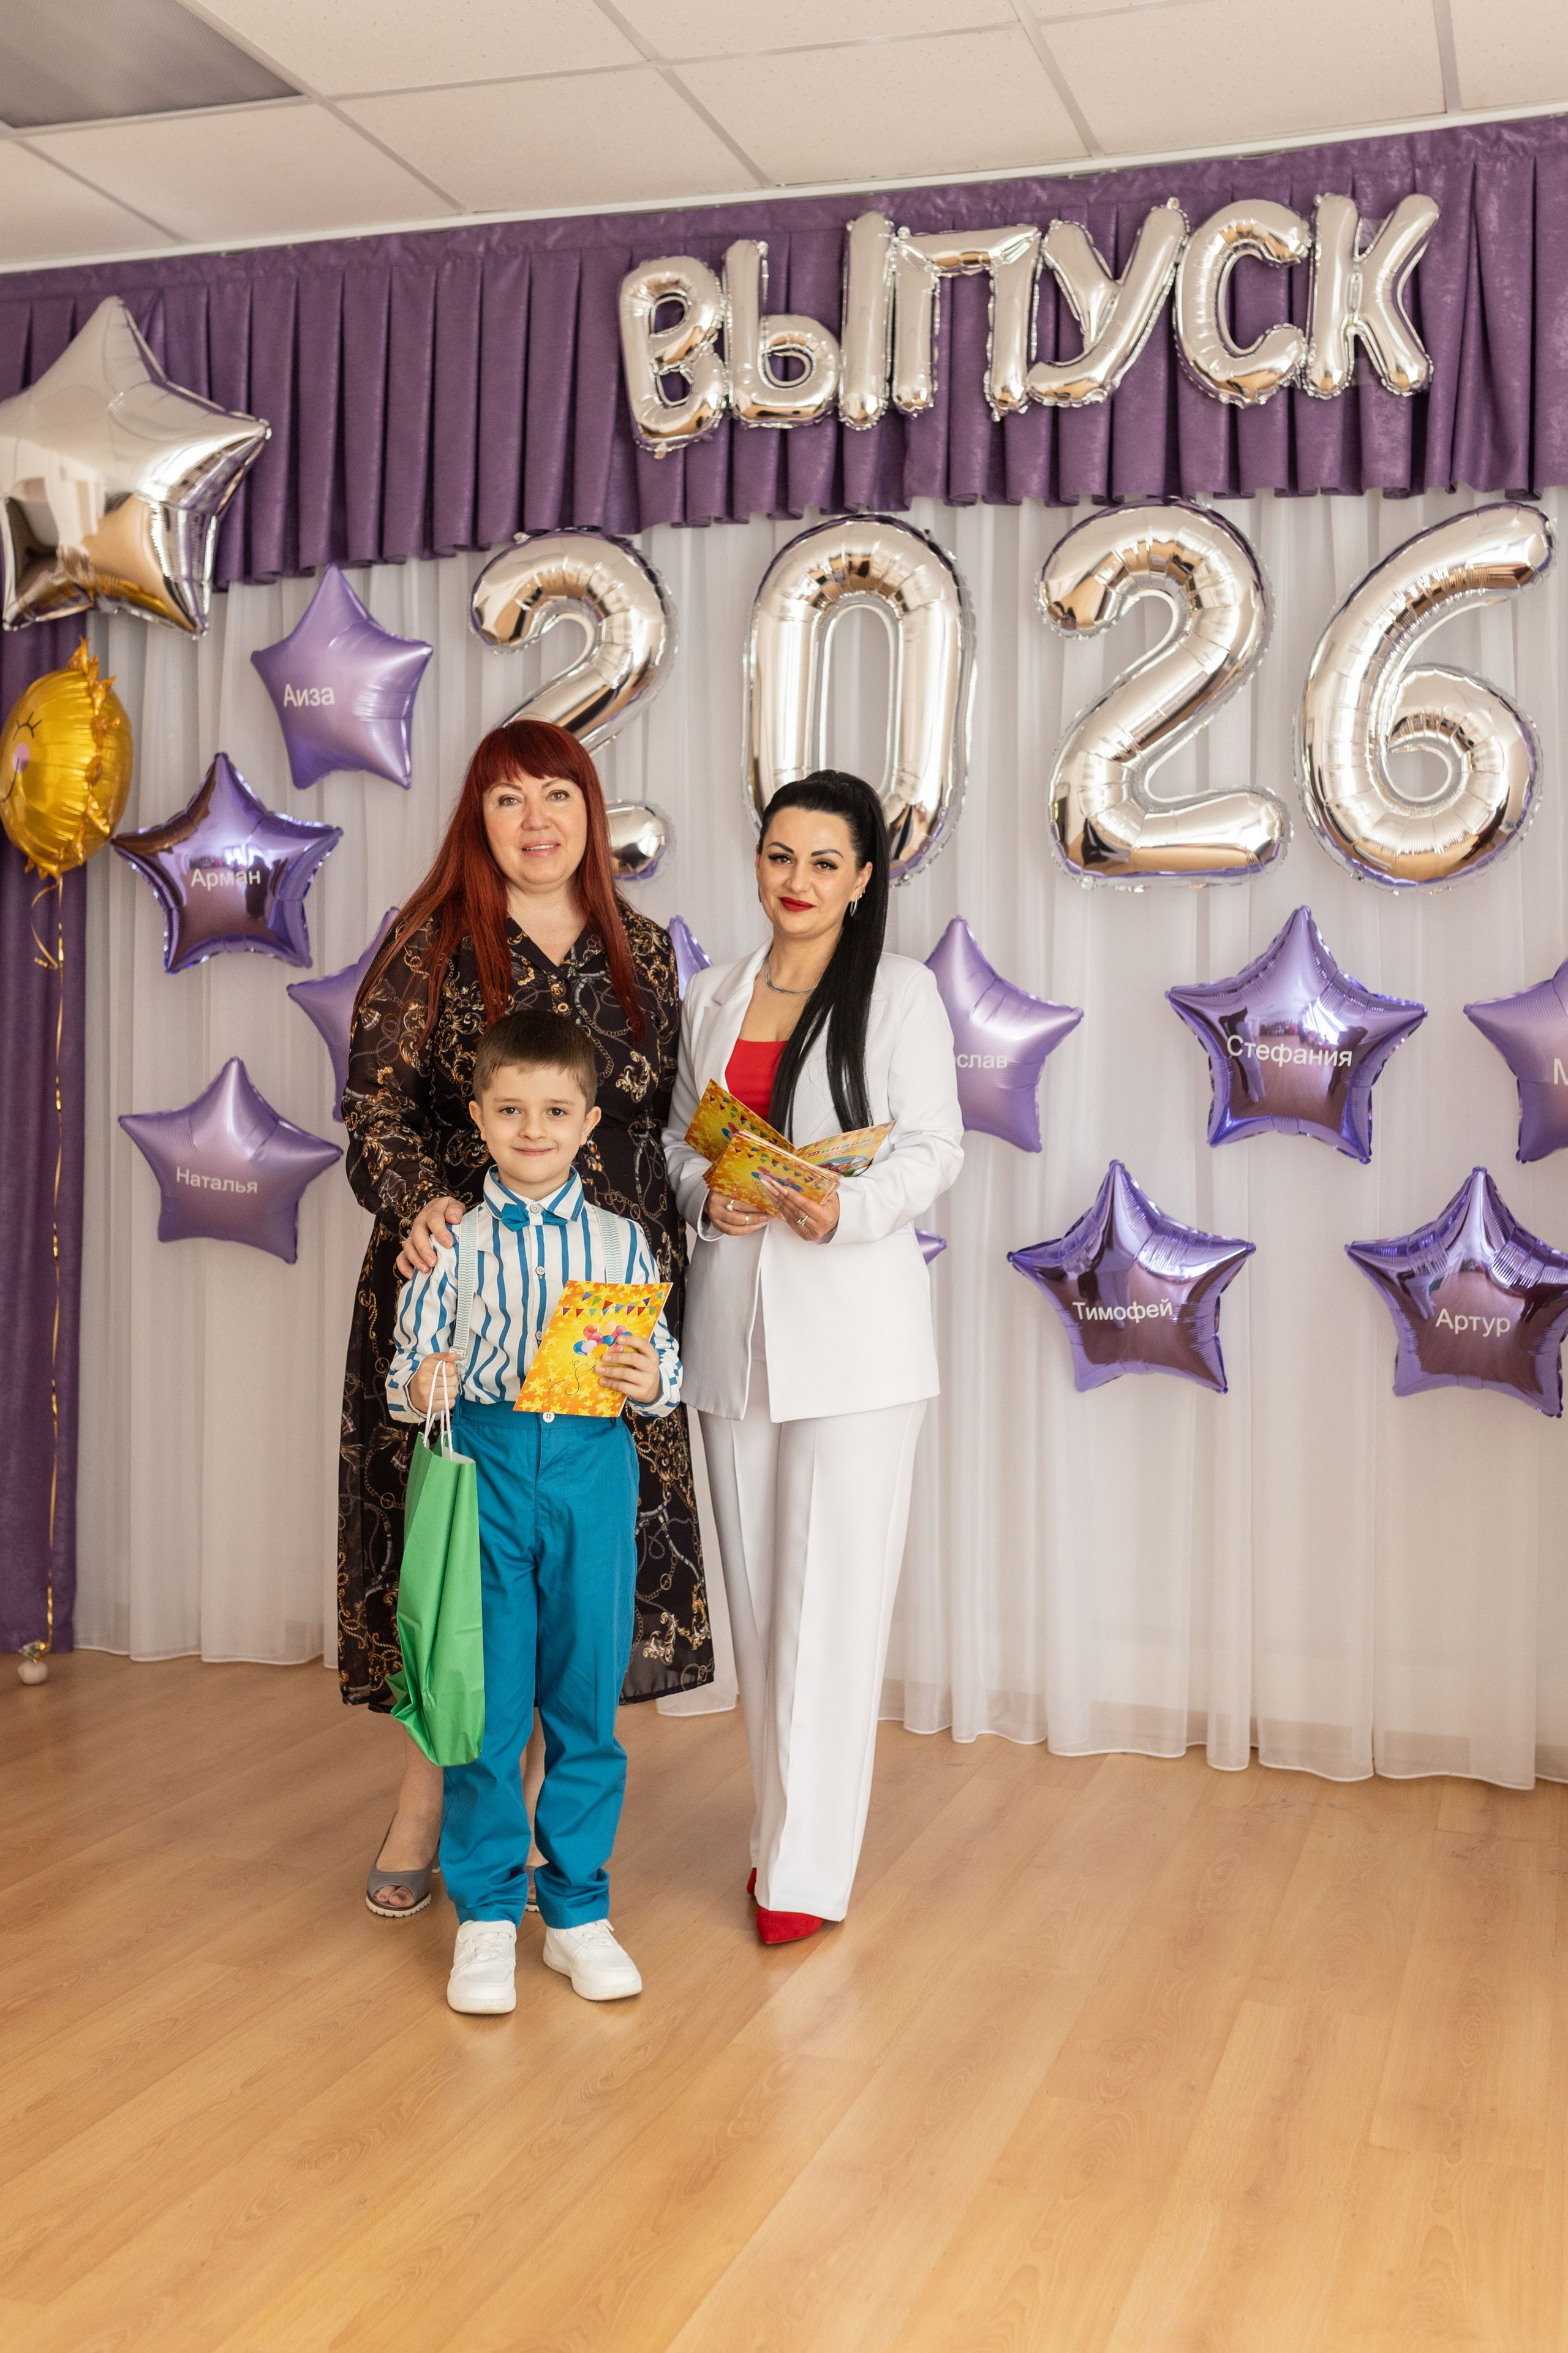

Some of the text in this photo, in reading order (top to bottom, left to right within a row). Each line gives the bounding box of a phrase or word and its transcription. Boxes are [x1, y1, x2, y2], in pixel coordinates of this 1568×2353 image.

[620, 194, 1440, 456] ВЫПУСК
[284, 683, 335, 708] Аиза
[469, 500, 1558, 892] 2026
[190, 868, 261, 891] Арман
[956, 1054, 1008, 1069] слав
[1227, 1035, 1352, 1067] Стефания
[176, 1166, 258, 1194] Наталья
[1072, 1298, 1173, 1324] Тимофей
[1435, 1308, 1511, 1337] Артур
